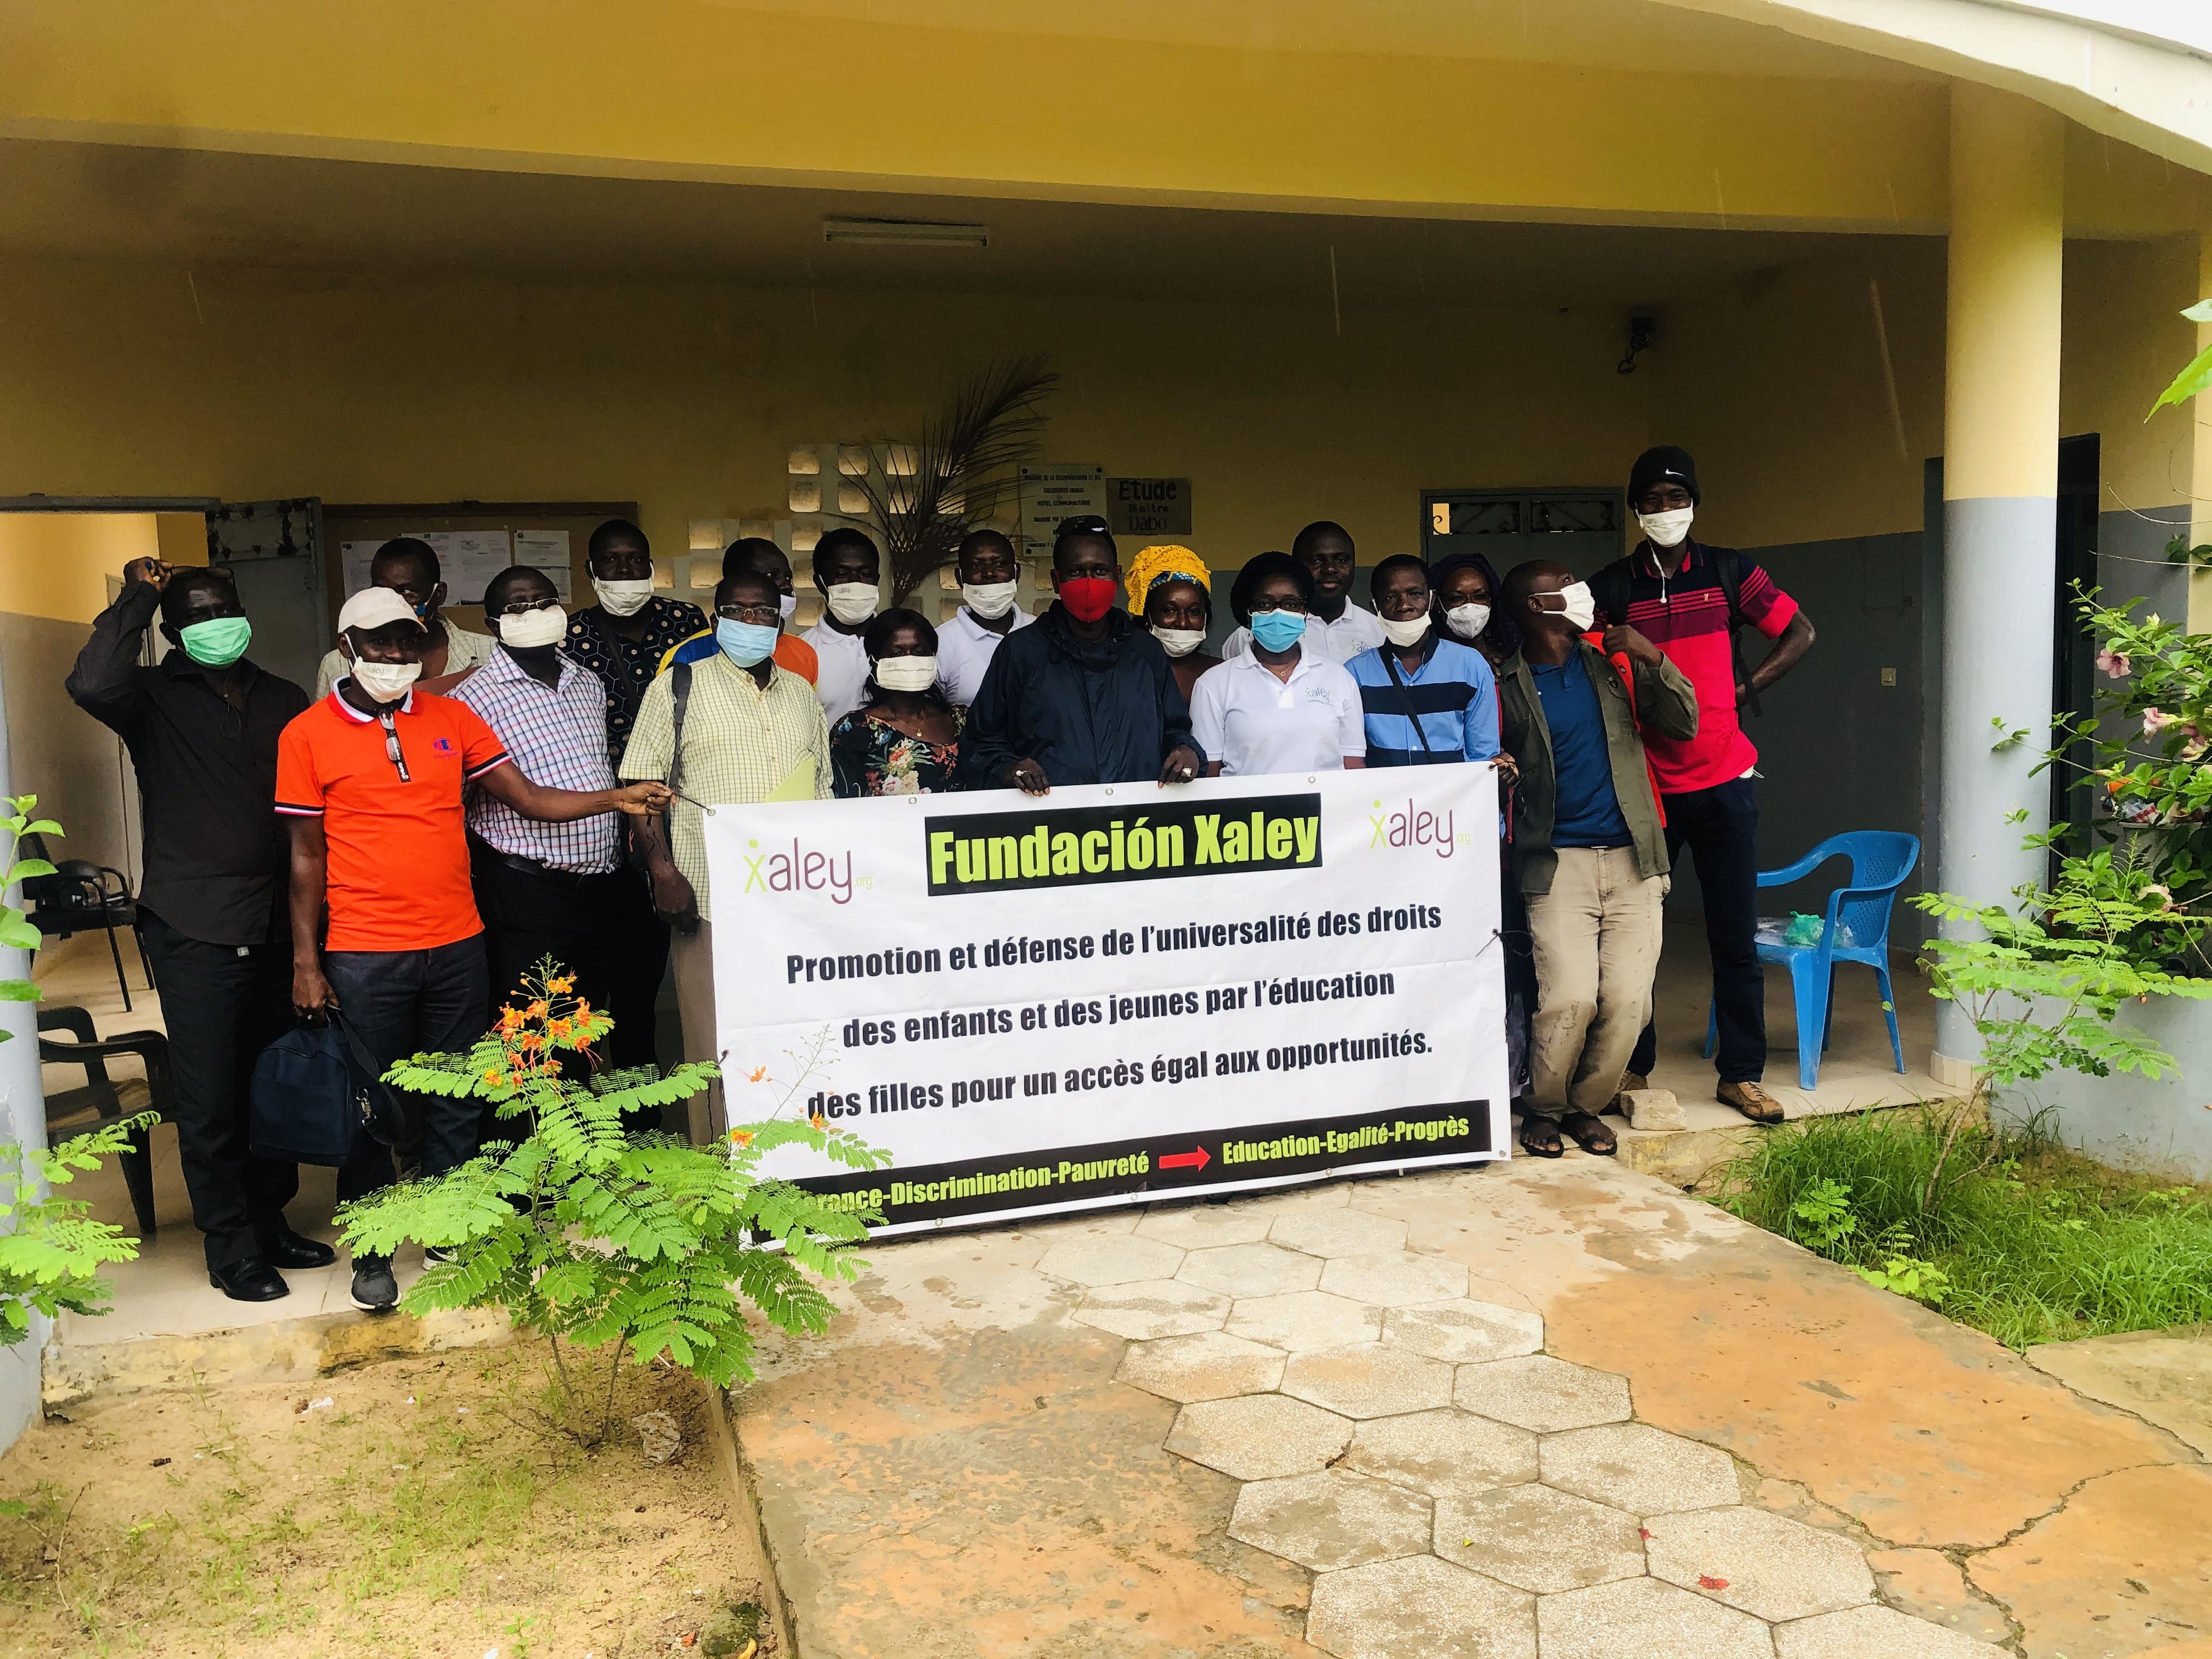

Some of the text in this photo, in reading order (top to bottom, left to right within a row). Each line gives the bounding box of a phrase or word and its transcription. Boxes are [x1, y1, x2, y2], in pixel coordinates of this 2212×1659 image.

[1119, 479, 1177, 500] Etude
[1129, 515, 1167, 531] Dabo
[1351, 640, 1369, 653] xale
[930, 812, 1318, 884] Fundación Xaley
[787, 946, 941, 984] Promotion
[949, 943, 977, 970] et
[985, 936, 1094, 967] défense
[1103, 929, 1134, 956] de
[1318, 911, 1361, 937] des
[1368, 904, 1441, 932] droits
[844, 1019, 896, 1047] des
[904, 1008, 1013, 1042] enfants
[1020, 1004, 1047, 1030] et
[1054, 1000, 1102, 1028] des
[1109, 991, 1199, 1024] jeunes
[1207, 985, 1248, 1014] par
[808, 1029, 1432, 1120] des filles pour un accès égal aux opportunités.
[816, 1115, 1469, 1211] rance-Discrimination-Pauvreté Education-Egalité-Progrès
